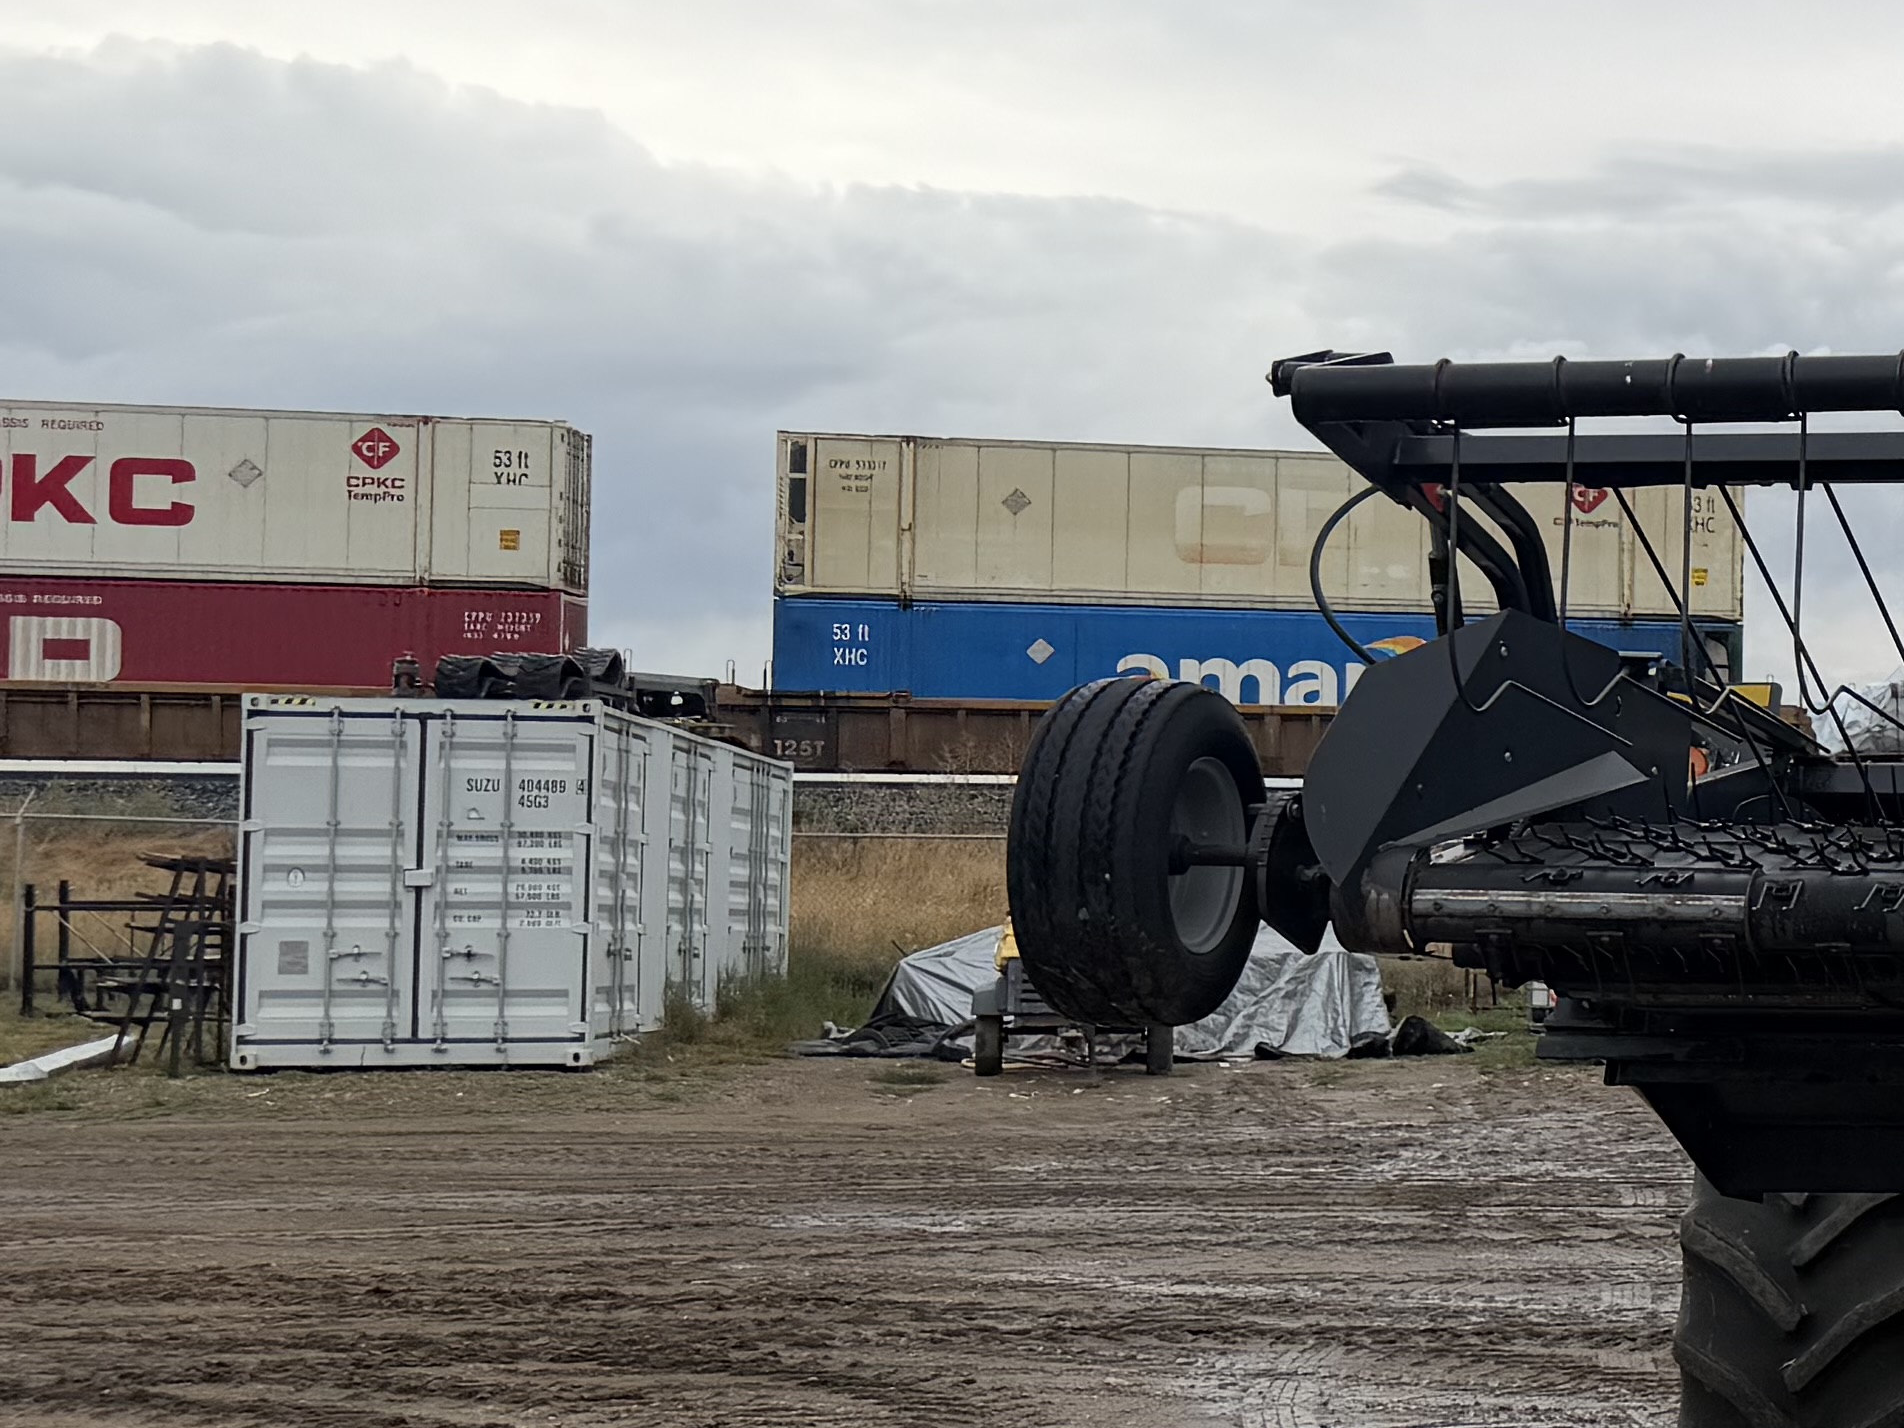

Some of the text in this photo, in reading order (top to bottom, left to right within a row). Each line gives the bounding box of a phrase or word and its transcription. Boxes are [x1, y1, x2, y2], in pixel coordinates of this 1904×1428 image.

[41, 419, 104, 430] REQUIRED
[493, 450, 512, 468] 53
[0, 453, 196, 526] KC
[346, 476, 405, 489] CPKC
[347, 489, 405, 504] TempPro
[832, 623, 870, 641] 53 ft
[833, 647, 868, 665] XHC
[466, 778, 500, 792] SUZU
[518, 778, 566, 793] 404489
[518, 794, 549, 808] 45G3
